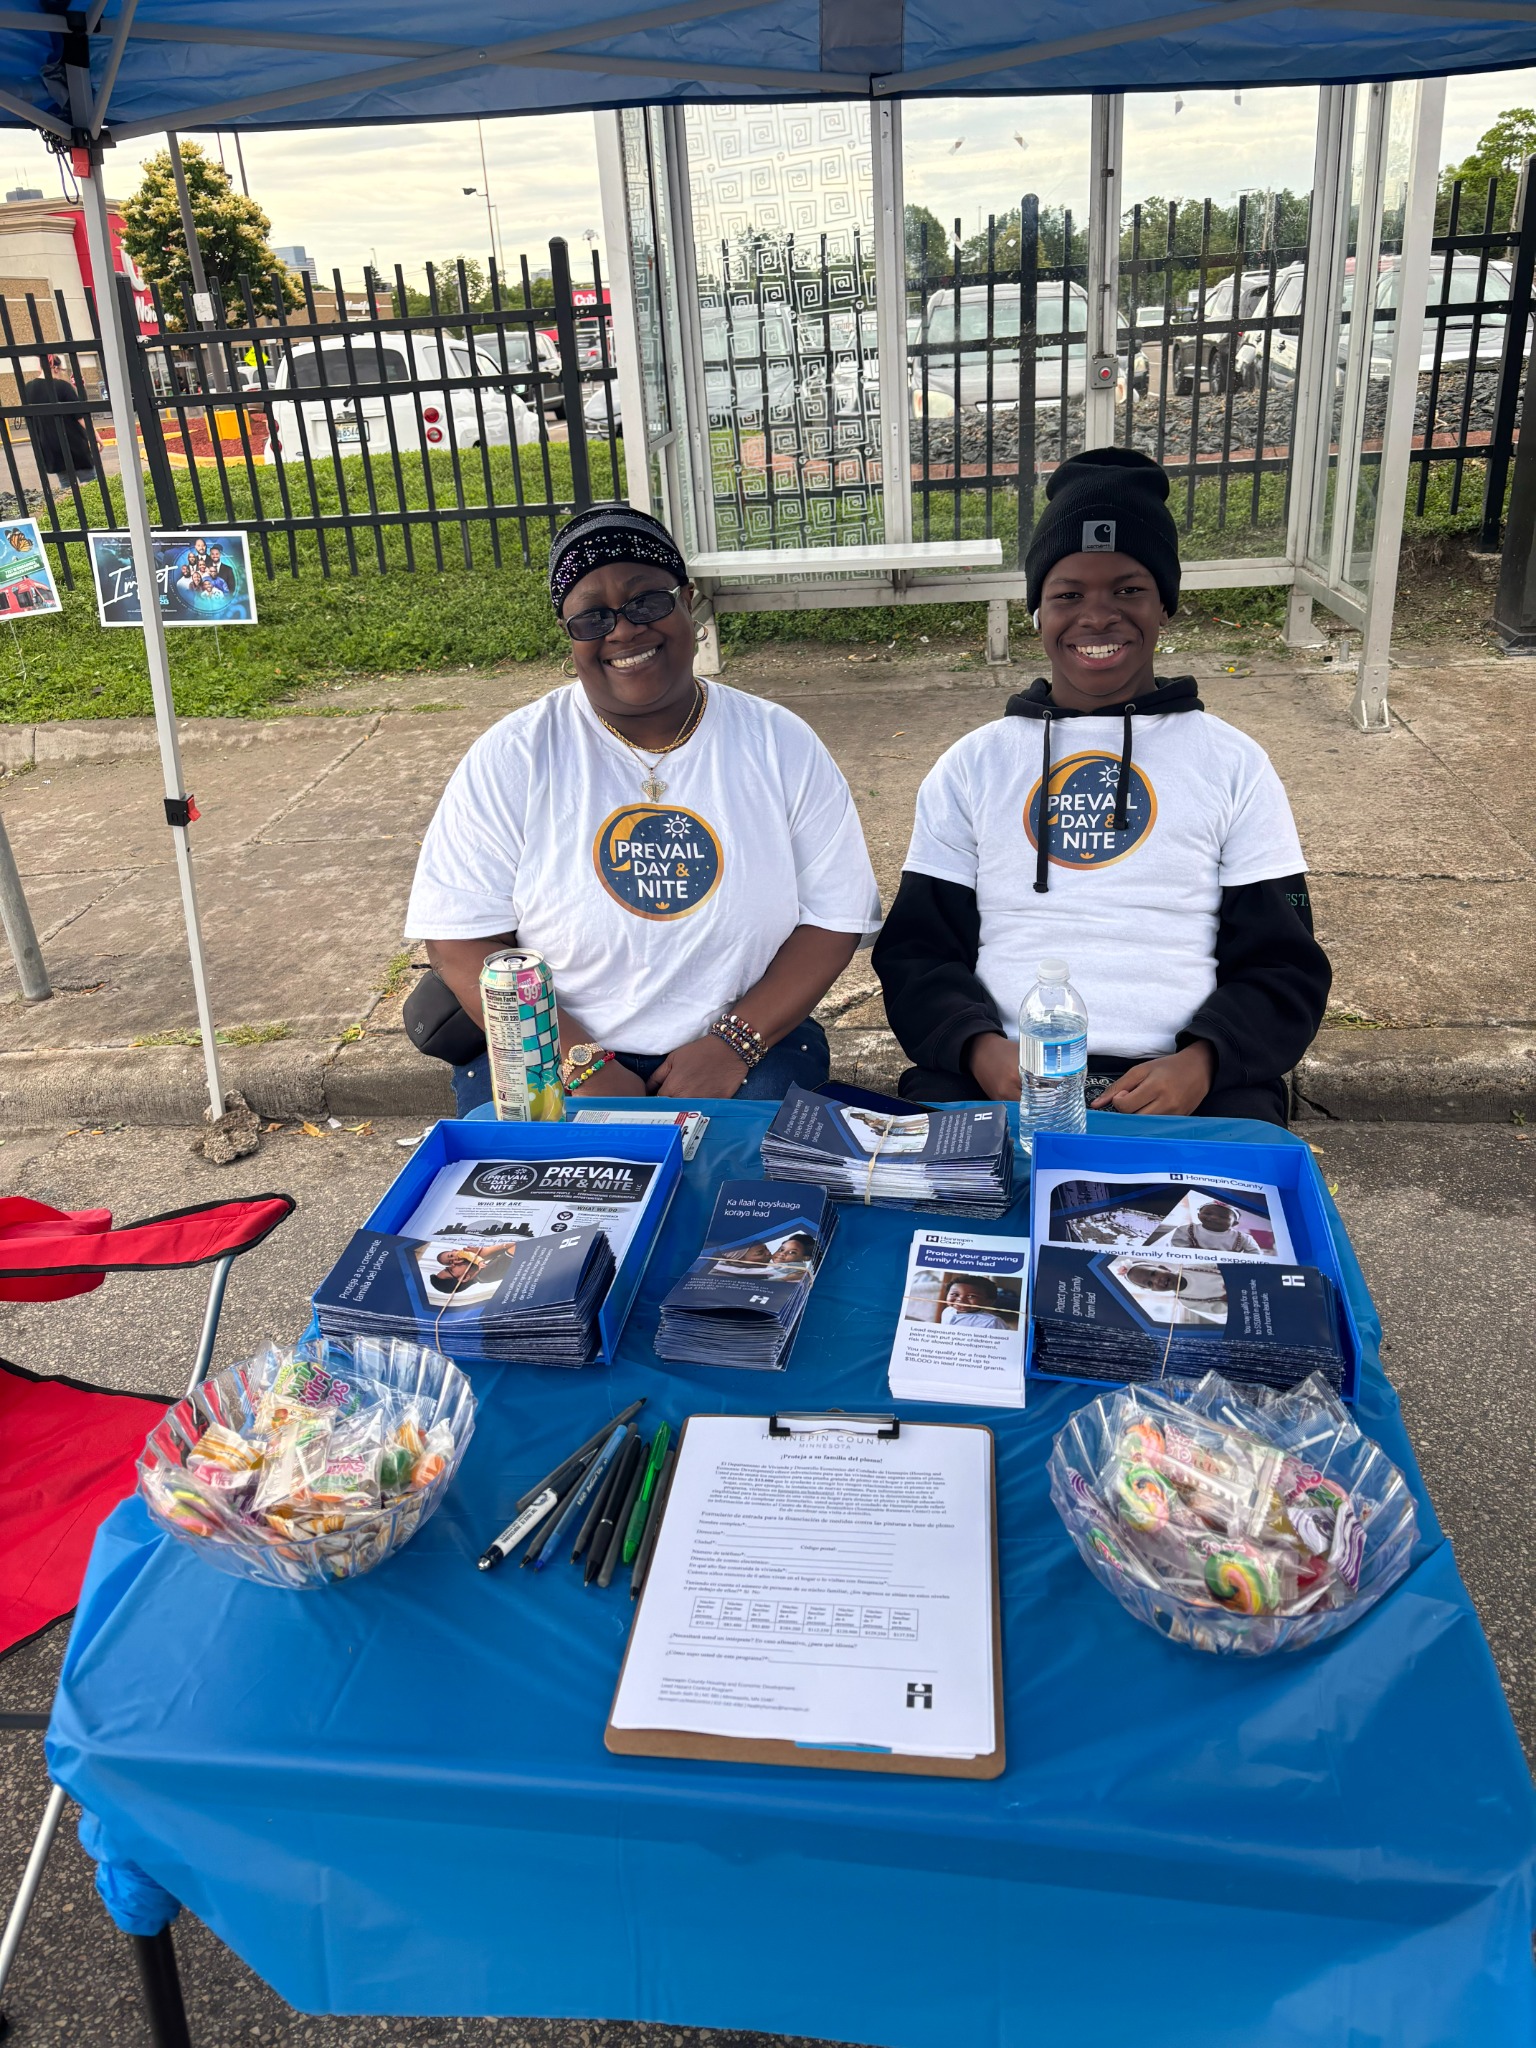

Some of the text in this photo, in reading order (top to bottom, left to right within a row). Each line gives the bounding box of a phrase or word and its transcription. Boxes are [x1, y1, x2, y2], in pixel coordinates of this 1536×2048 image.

[575, 294, 597, 306] Cub
[1048, 793, 1137, 811] PREVAL
[1061, 814, 1101, 828] DAY
[1063, 832, 1115, 849] NITE
[618, 841, 705, 859] PREVAIL
[634, 861, 690, 877] DAY &
[638, 879, 688, 898] NITE
[544, 1167, 633, 1181] PREVAIL
[539, 1179, 575, 1187] DAY
[576, 1179, 589, 1188] &
[592, 1180, 633, 1191] NITE
[1186, 1175, 1263, 1190] Hennepin County
[758, 1200, 800, 1210] qoyskaaga
[724, 1209, 750, 1218] koraya
[373, 1251, 389, 1270] plomo
[925, 1256, 951, 1264] family
[982, 1255, 1018, 1263] growing
[1132, 1250, 1162, 1259] family
[1166, 1252, 1192, 1260] from
[1195, 1254, 1217, 1262] lead
[1086, 1292, 1096, 1304] lead
